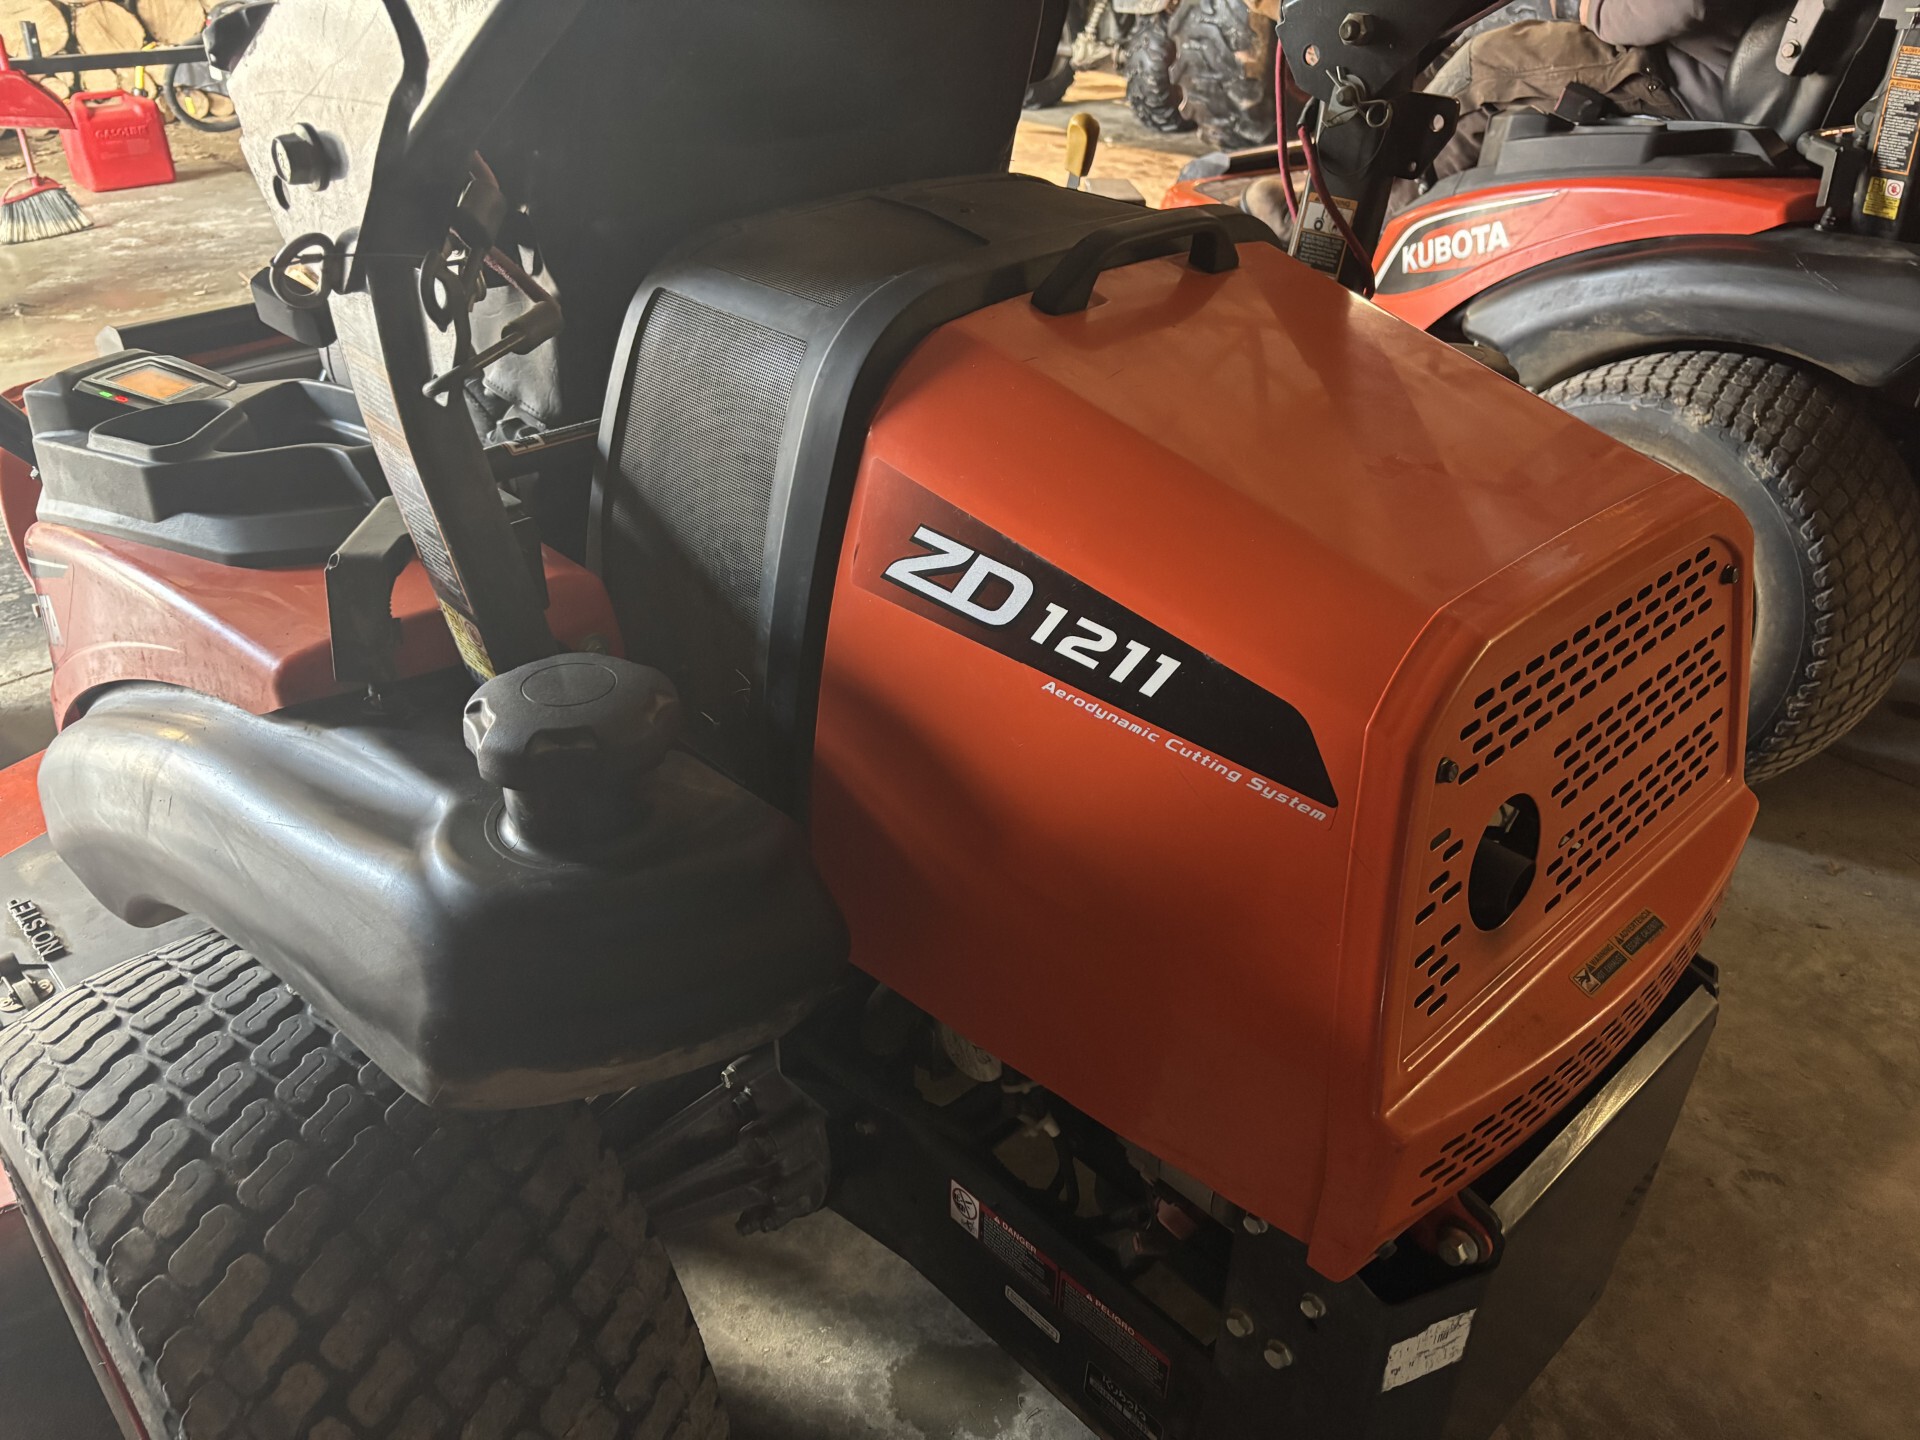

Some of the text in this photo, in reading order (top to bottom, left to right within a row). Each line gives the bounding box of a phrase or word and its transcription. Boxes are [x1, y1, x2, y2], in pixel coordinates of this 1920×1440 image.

[95, 125, 148, 139] GASOLINE
[1402, 220, 1510, 274] KUBOTA
[883, 524, 1182, 698] ZD 1211
[1041, 680, 1329, 824] Aerodynamic Cutting System
[7, 899, 65, 962] NO STEP
[1619, 908, 1651, 938] ADVERTENCIA
[1590, 942, 1614, 966] WARNING
[1002, 1222, 1037, 1254] DANGER
[1095, 1299, 1136, 1337] PELIGRO
